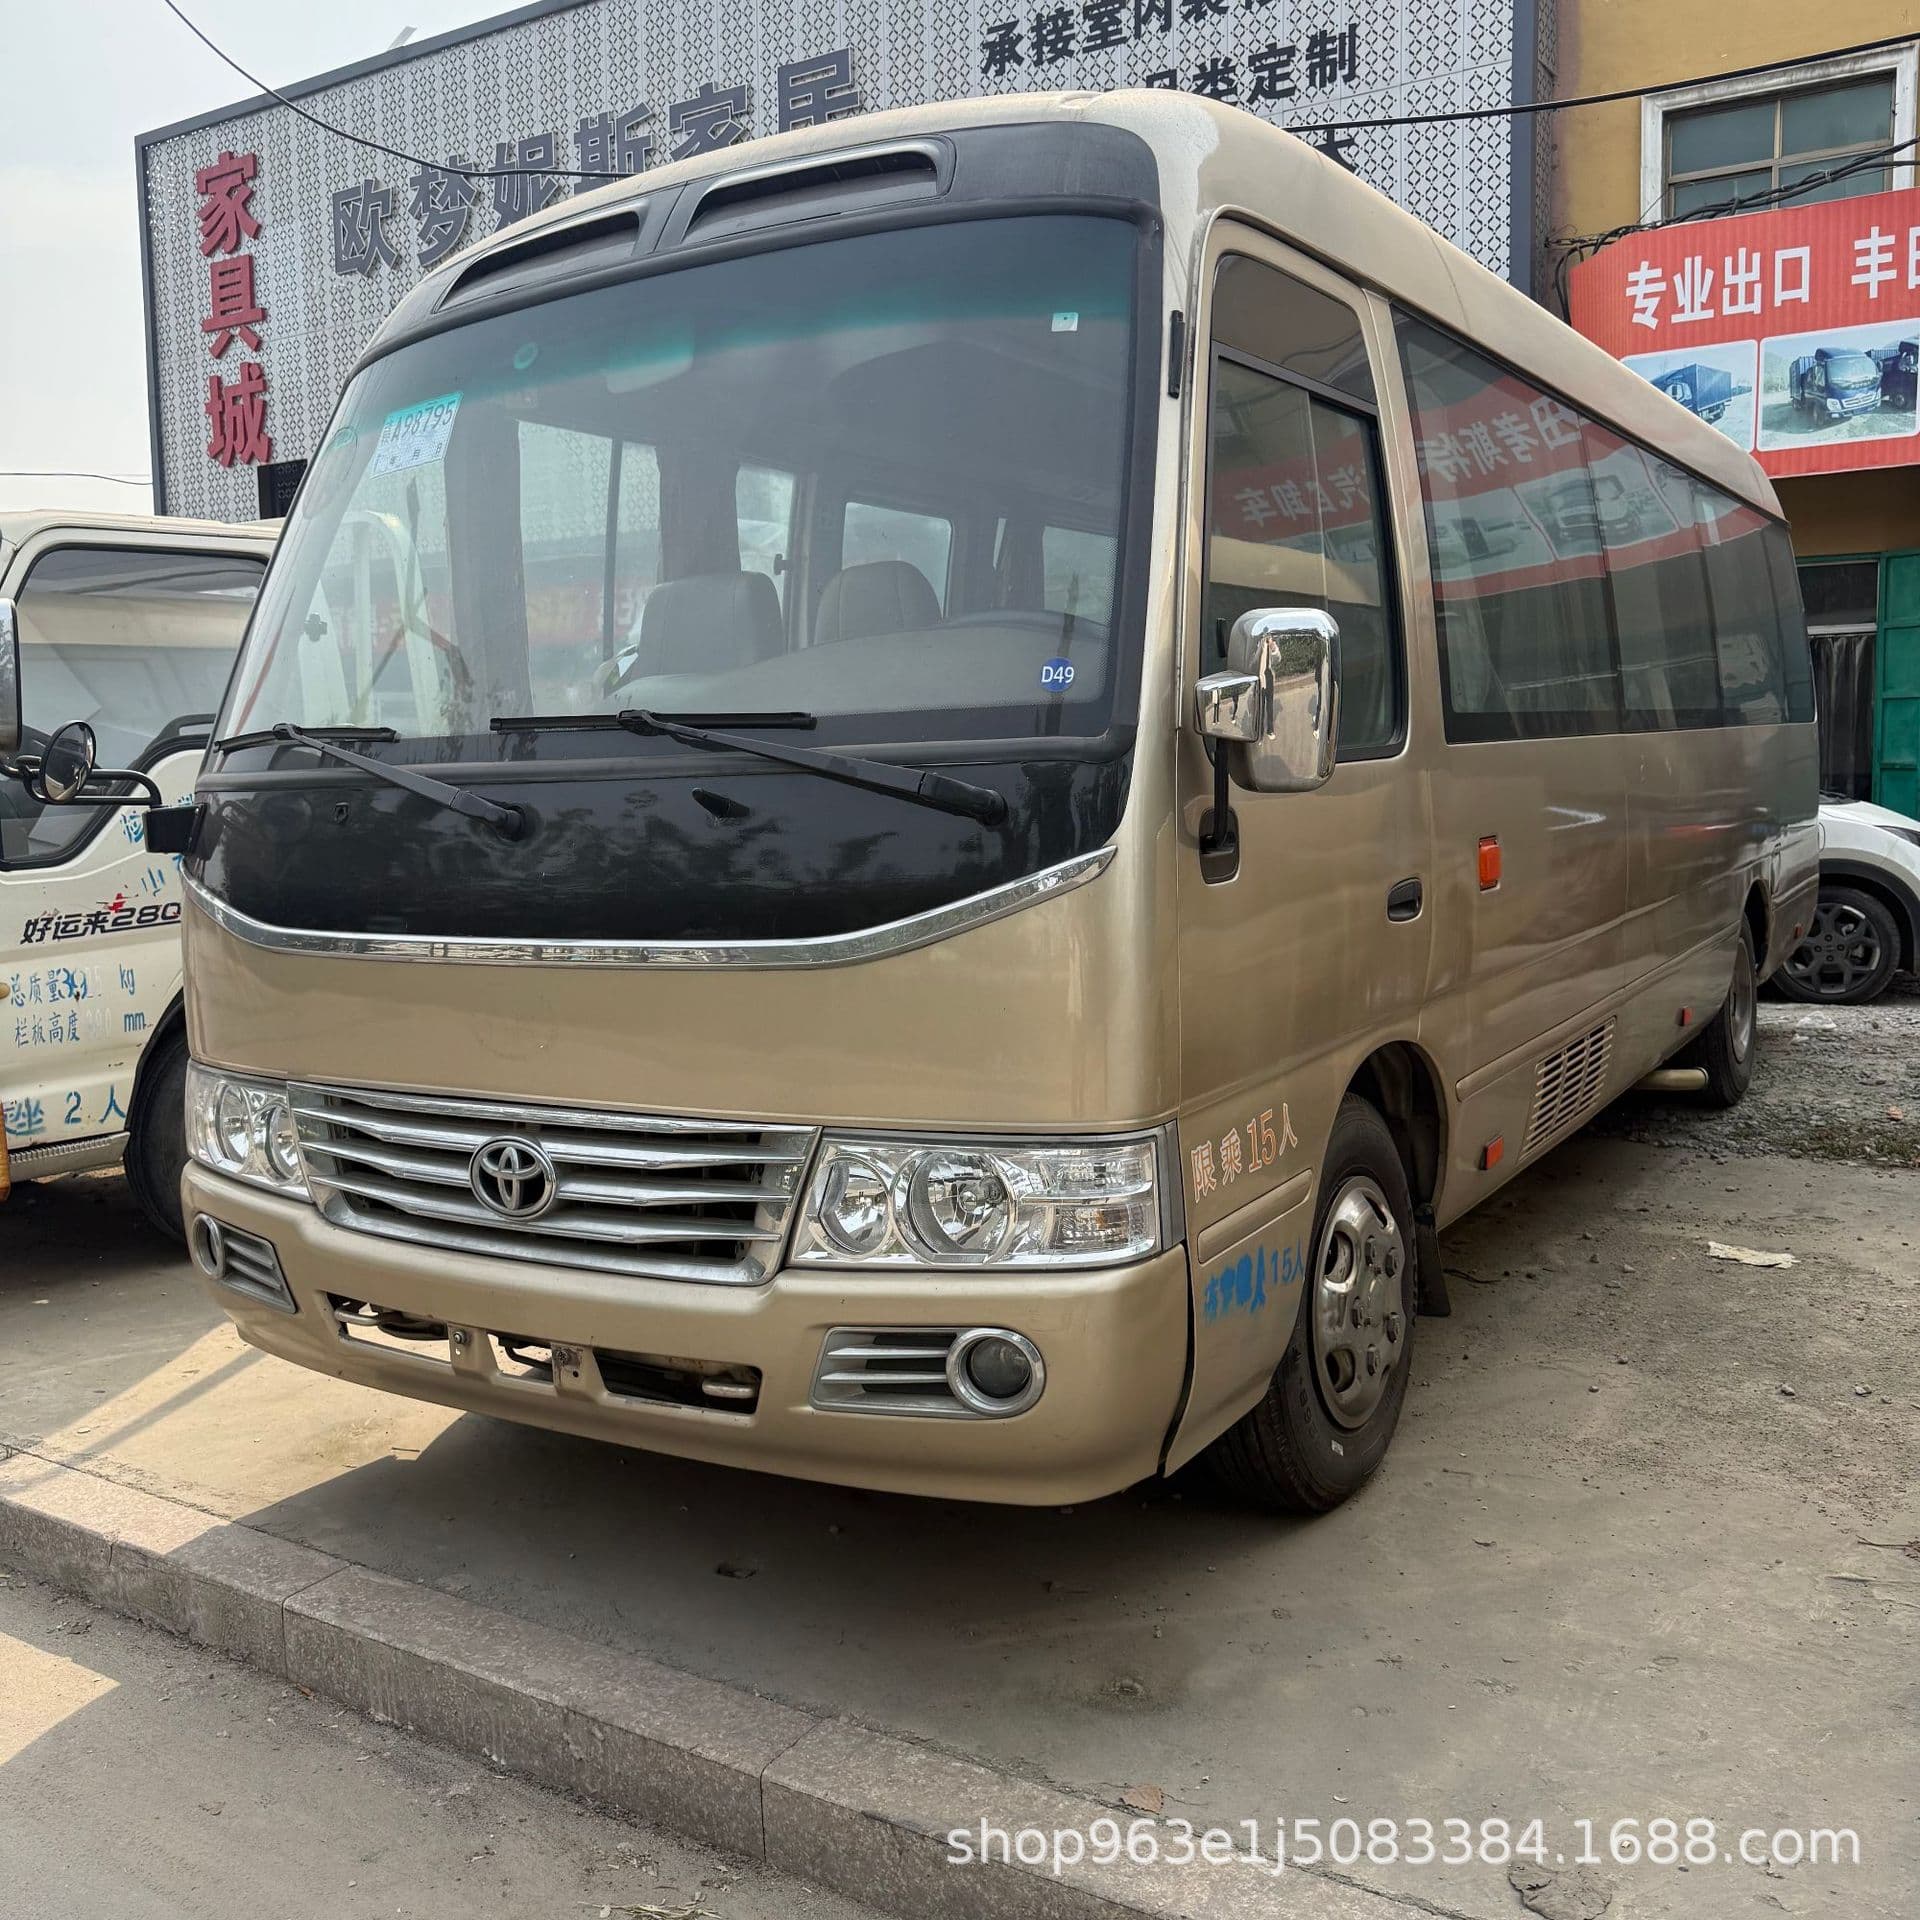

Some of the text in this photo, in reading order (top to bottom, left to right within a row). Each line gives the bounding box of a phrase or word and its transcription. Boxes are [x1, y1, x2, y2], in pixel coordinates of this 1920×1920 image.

[981, 0, 1270, 77] 承接室内
[332, 46, 860, 278] 欧梦妮斯家居
[195, 150, 272, 468] 家具城
[1626, 246, 1811, 331] 专业出口
[1041, 665, 1075, 684] D49
[20, 901, 181, 945] 好运来280
[119, 964, 136, 996] kg
[15, 1009, 80, 1049] 栏板高度
[123, 1011, 146, 1033] mm
[64, 1090, 82, 1125] 2
[98, 1083, 126, 1125] 人
[1191, 1102, 1298, 1204] 限乘15人
